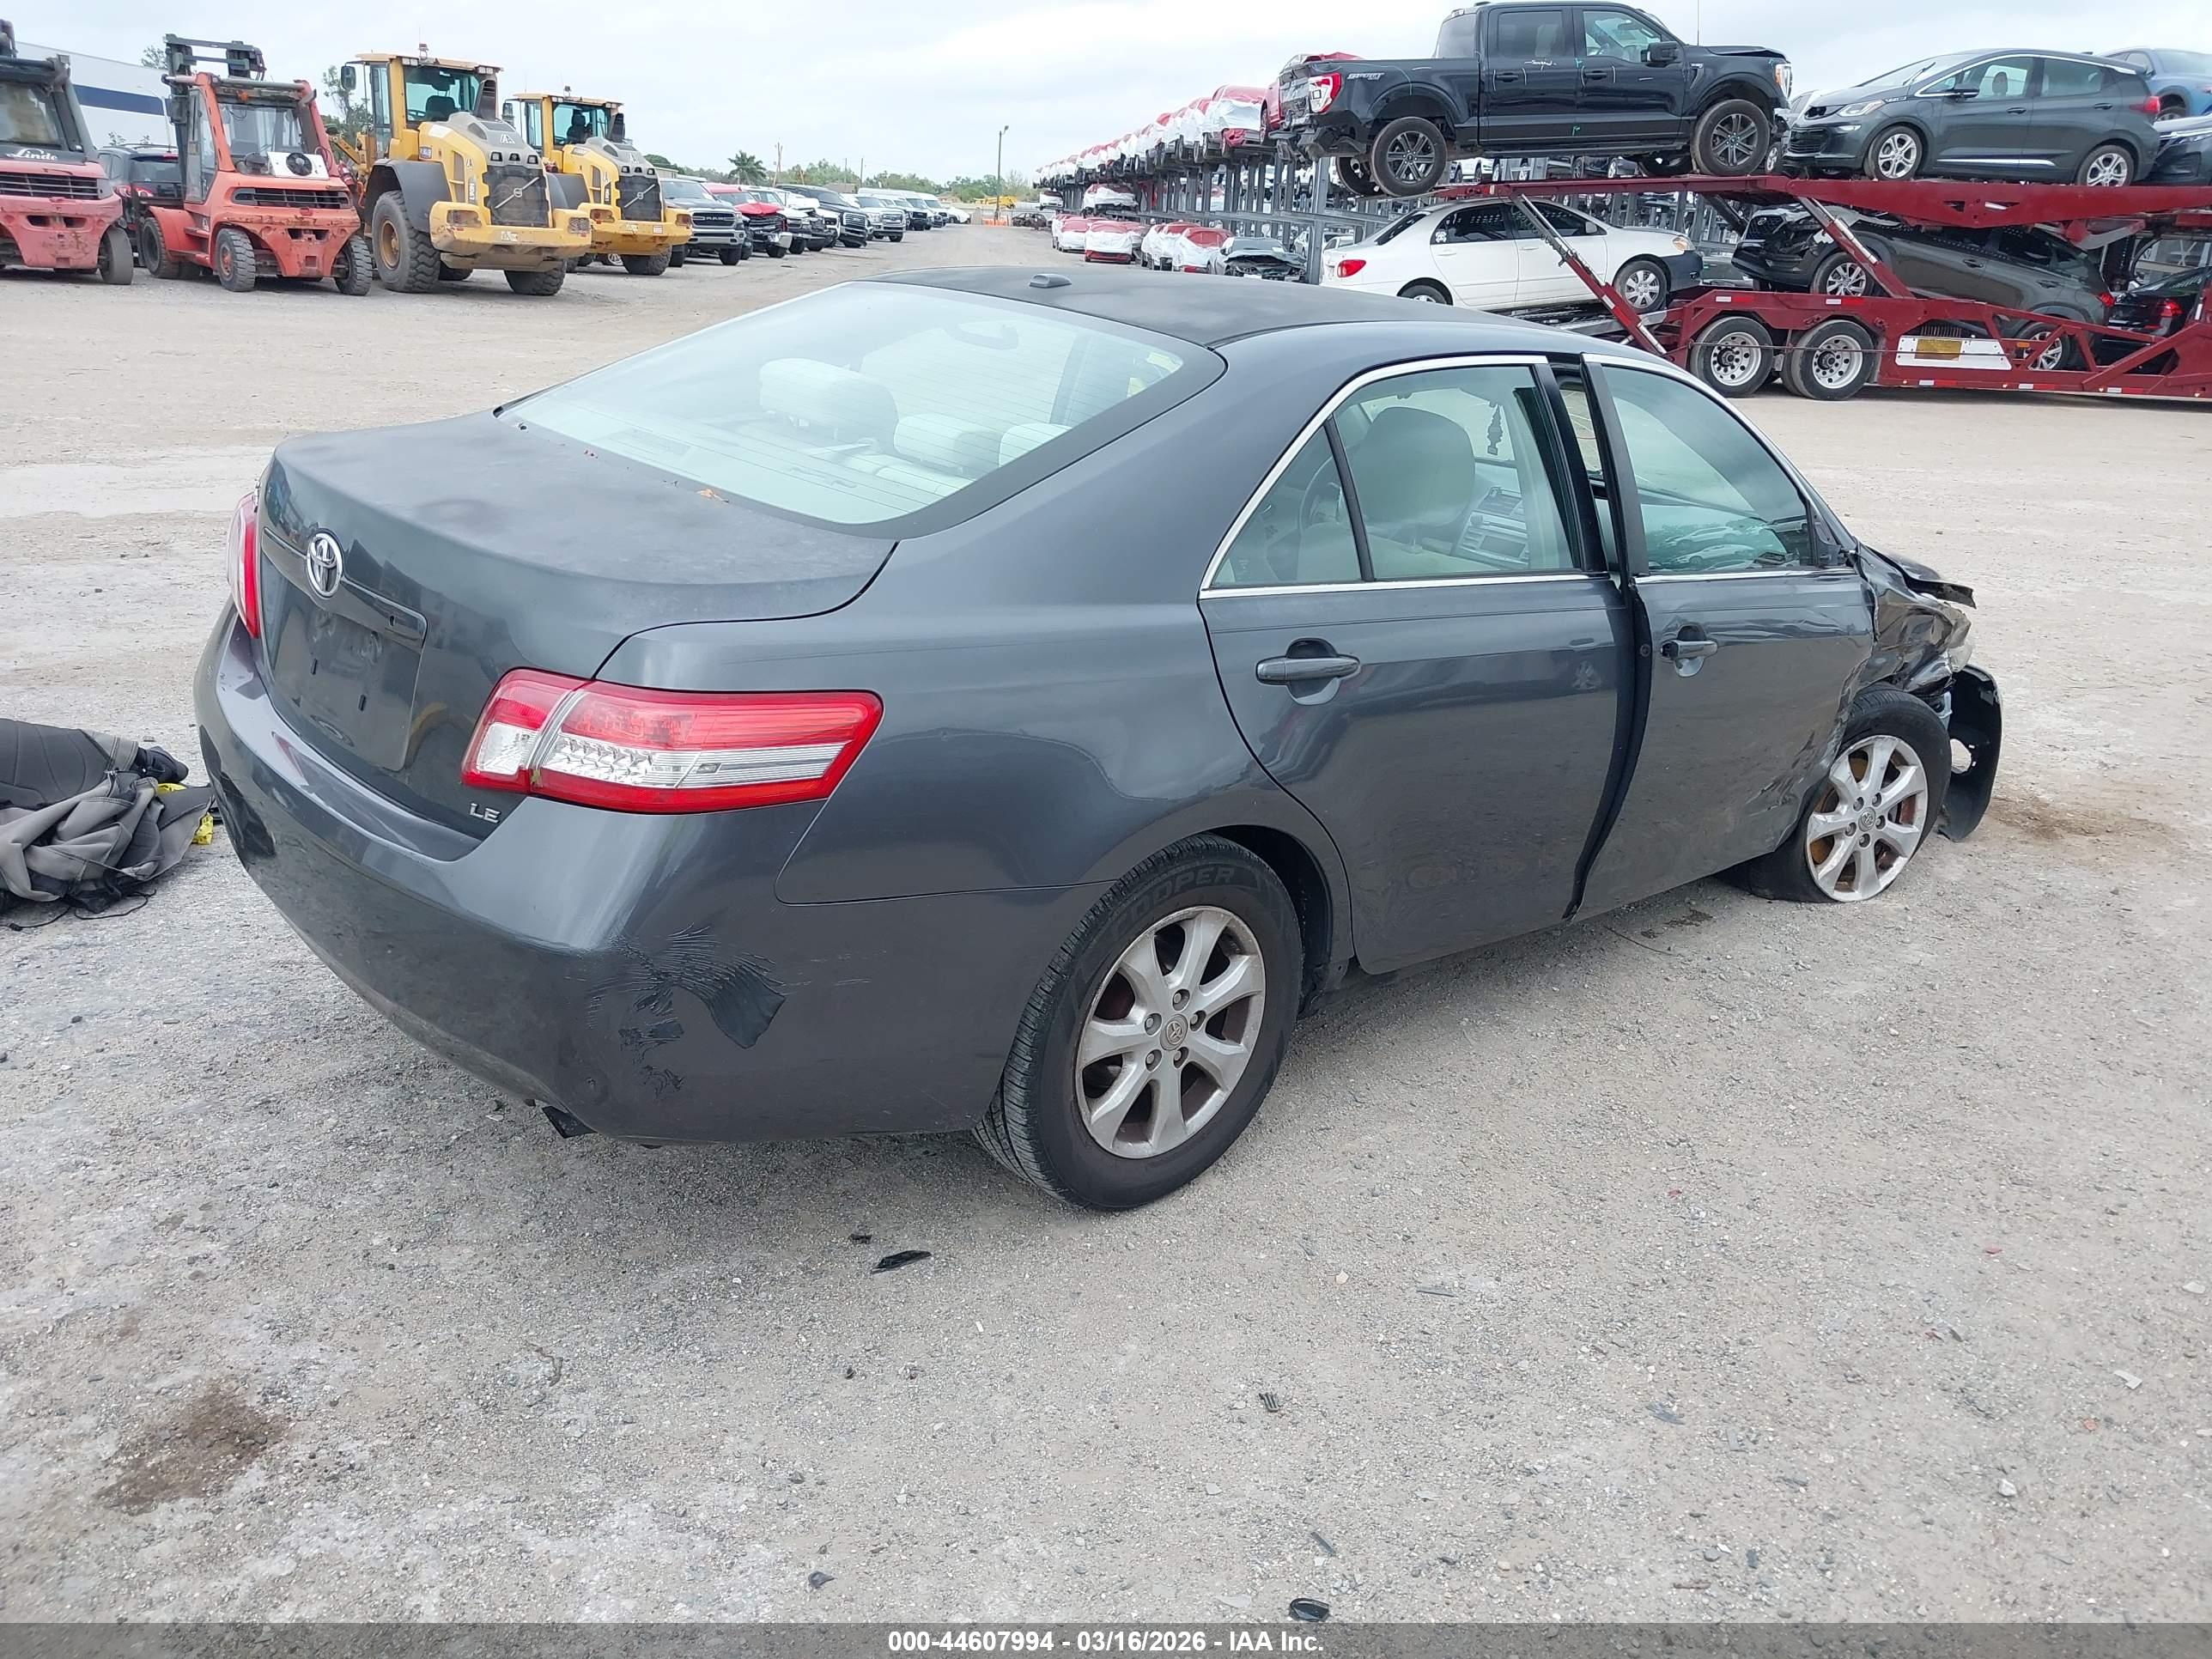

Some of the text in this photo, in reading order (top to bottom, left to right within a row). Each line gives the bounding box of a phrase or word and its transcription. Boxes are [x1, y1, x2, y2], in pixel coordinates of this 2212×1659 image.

[6, 148, 58, 161] Linde
[470, 803, 501, 823] LE
[1111, 866, 1235, 936] COOPER
